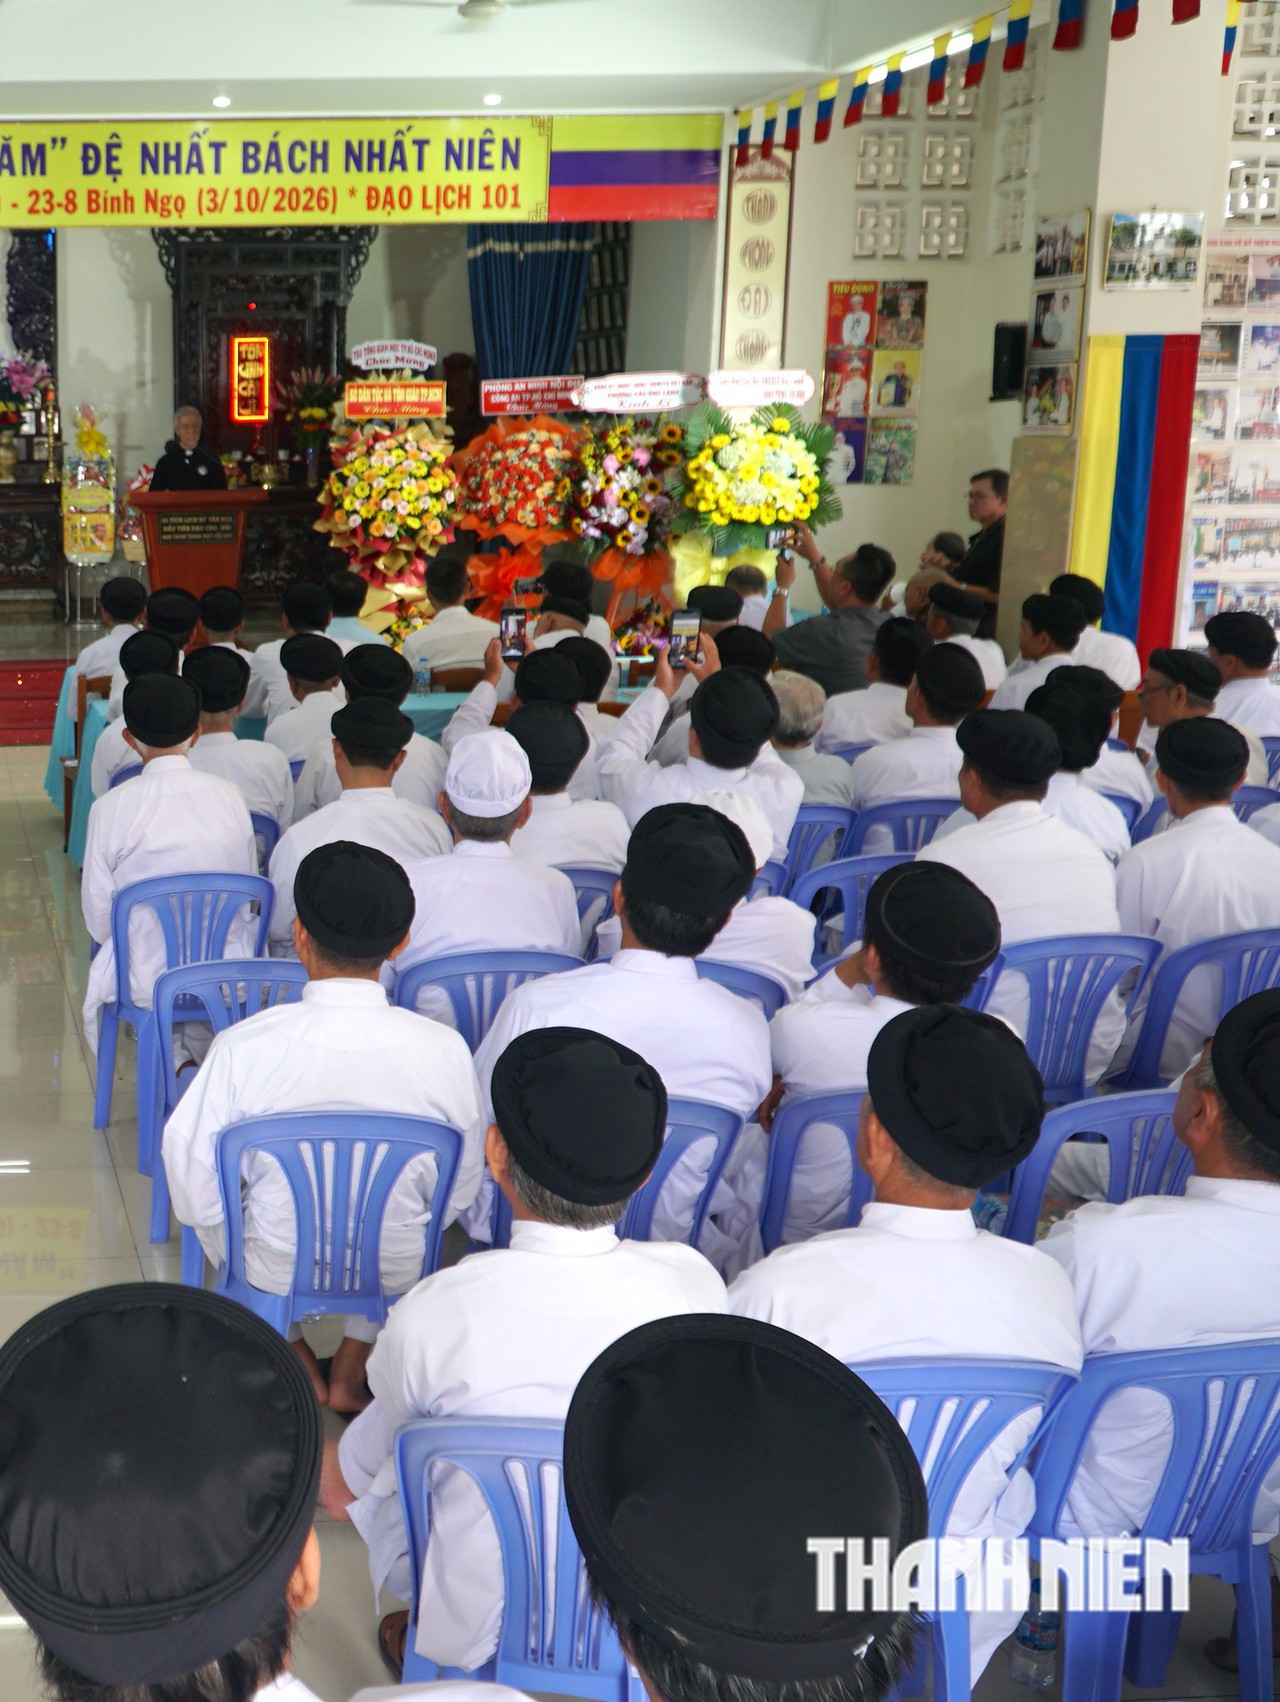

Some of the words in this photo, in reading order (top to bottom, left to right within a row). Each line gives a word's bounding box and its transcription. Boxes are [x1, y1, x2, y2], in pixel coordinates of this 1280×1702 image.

[80, 133, 123, 183] ĐỆ
[140, 127, 227, 175] NHẤT
[241, 131, 330, 174] BÁCH
[344, 125, 431, 173] NHẤT
[445, 128, 521, 171] NIÊN
[27, 189, 78, 215] 23-8
[87, 188, 135, 215] Bính
[144, 188, 186, 219] Ngọ
[197, 186, 338, 217] (3/10/2026)
[365, 184, 413, 216] ĐẠO
[421, 184, 472, 216] LỊCH
[482, 183, 521, 210] 101
[514, 383, 526, 391] AN
